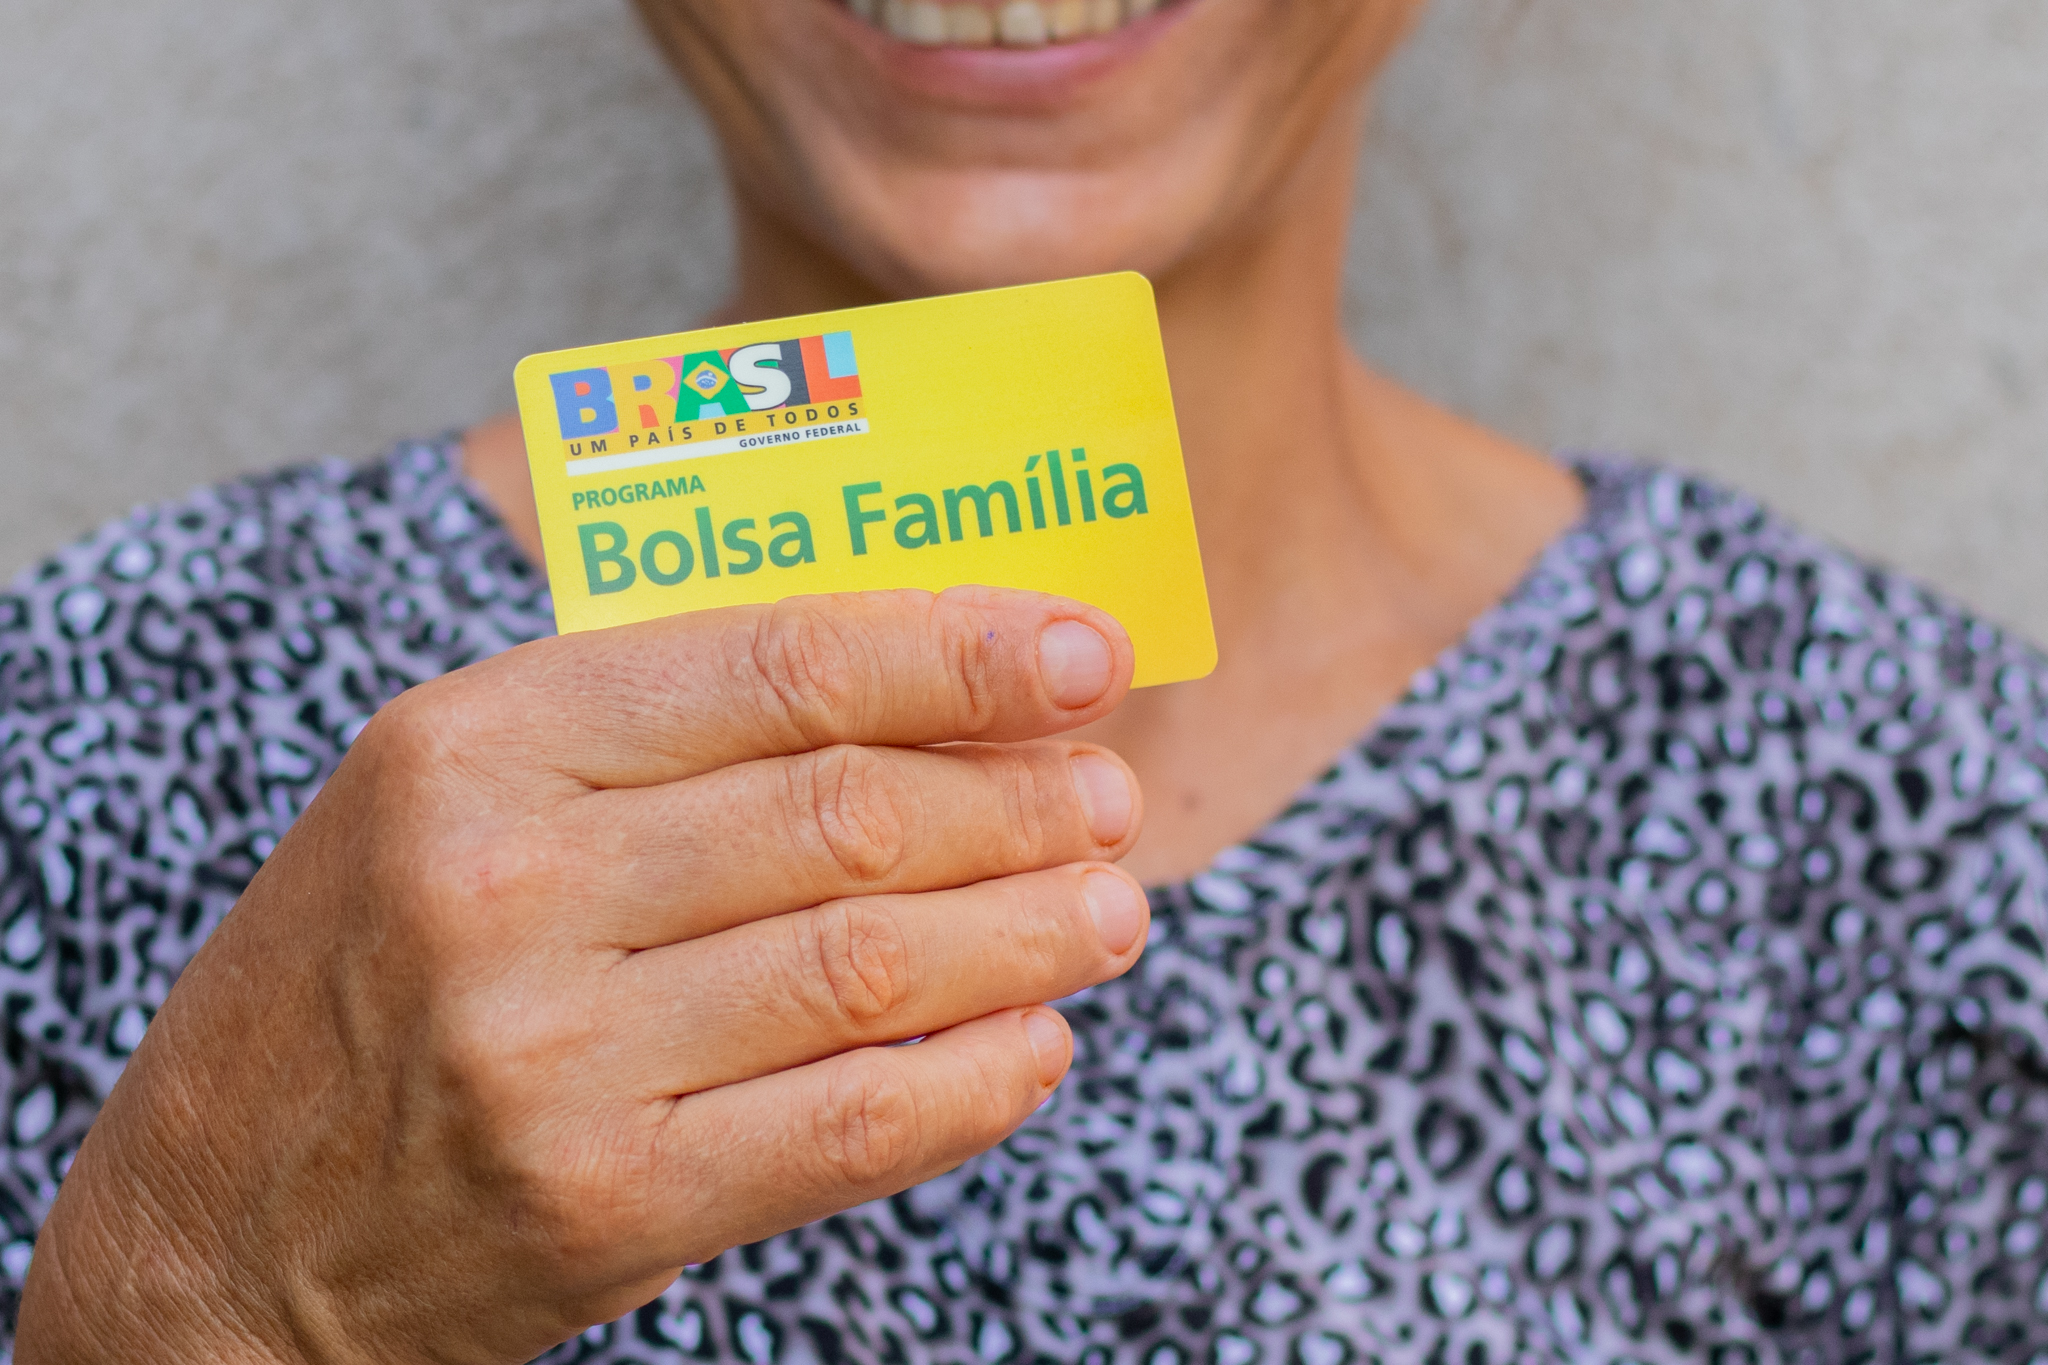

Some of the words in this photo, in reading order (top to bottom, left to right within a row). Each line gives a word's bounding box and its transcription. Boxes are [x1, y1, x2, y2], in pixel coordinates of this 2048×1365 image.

[549, 331, 863, 440] BRASIL
[570, 439, 607, 457] UM
[630, 426, 693, 447] PAÍS
[715, 418, 746, 435] DE
[767, 402, 859, 427] TODOS
[739, 431, 801, 448] GOVERNO
[805, 423, 862, 438] FEDERAL
[572, 474, 706, 511] PROGRAMA
[577, 506, 816, 596] Bolsa
[842, 447, 1149, 556] Família
